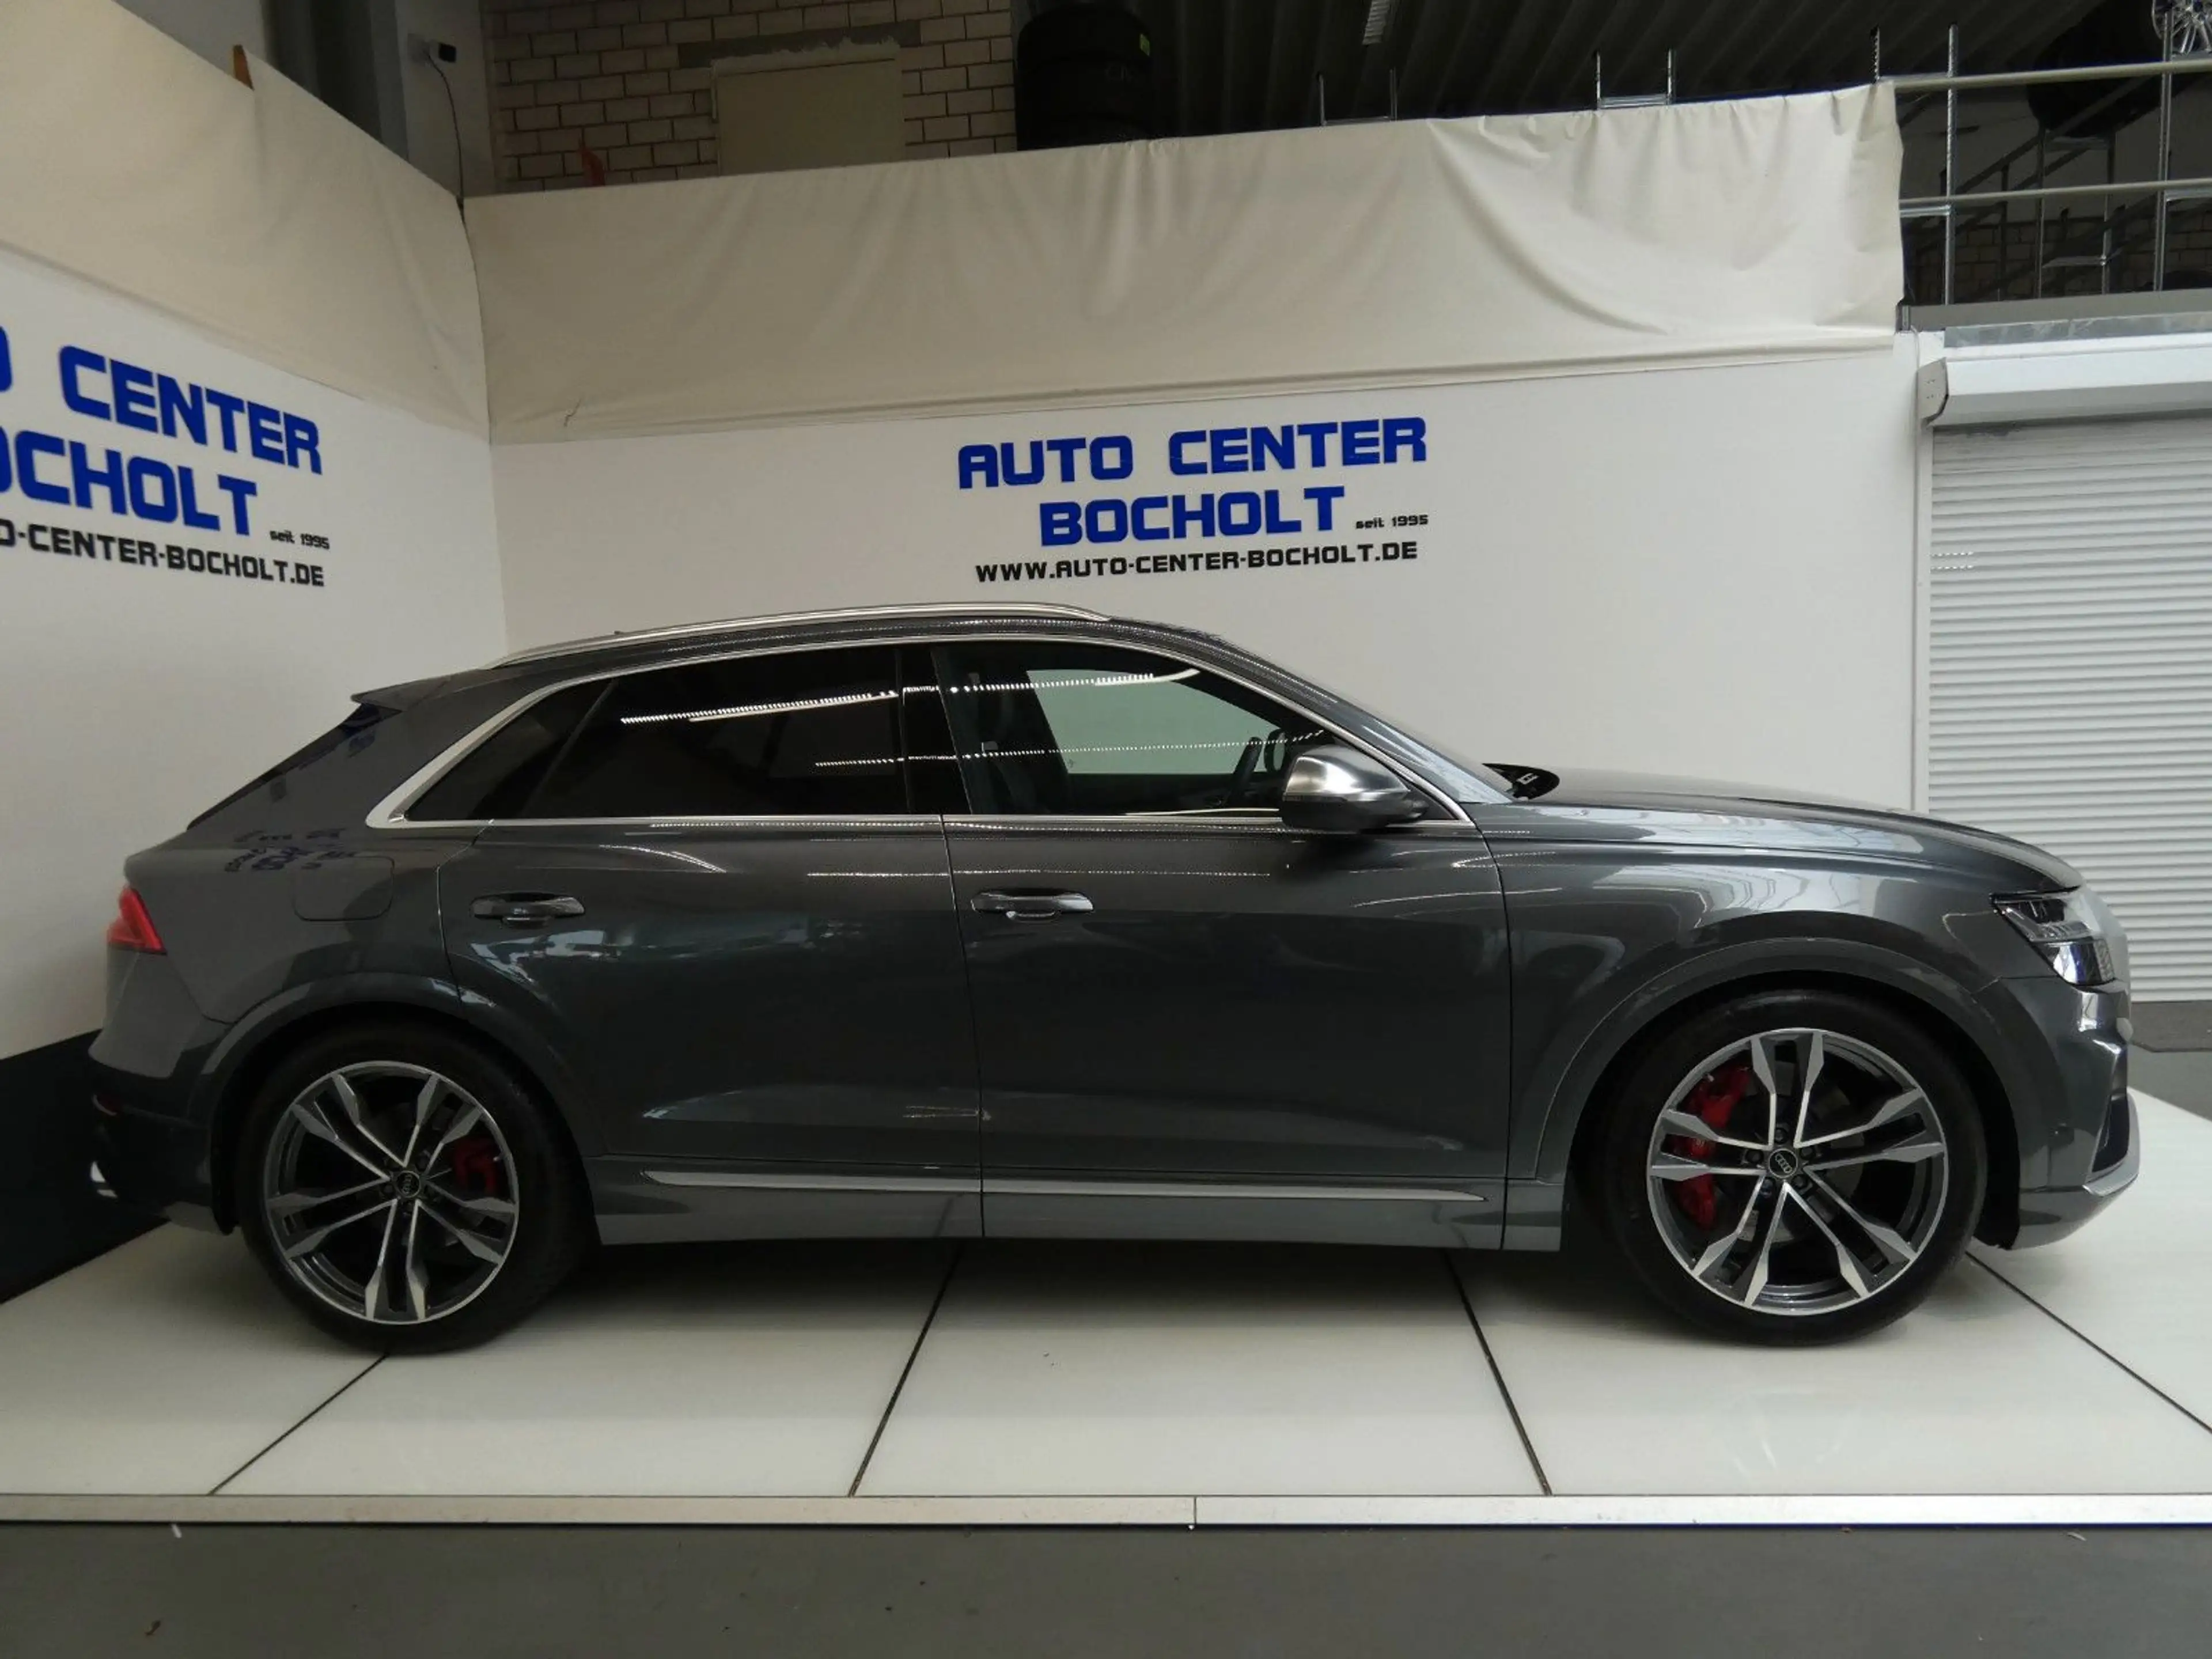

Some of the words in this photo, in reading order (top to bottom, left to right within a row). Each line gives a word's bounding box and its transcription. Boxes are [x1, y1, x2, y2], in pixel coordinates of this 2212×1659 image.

[60, 346, 323, 474] CENTER
[0, 426, 258, 536] CHOLT
[300, 533, 330, 550] 1995
[959, 435, 1135, 489] AUTO
[1169, 416, 1428, 477] CENTER
[1040, 486, 1346, 547] BOCHOLT
[1355, 517, 1385, 529] seit
[1392, 514, 1429, 527] 1995
[975, 541, 1418, 583] WWW.AUTO-CENTER-BOCHOLT.DE
